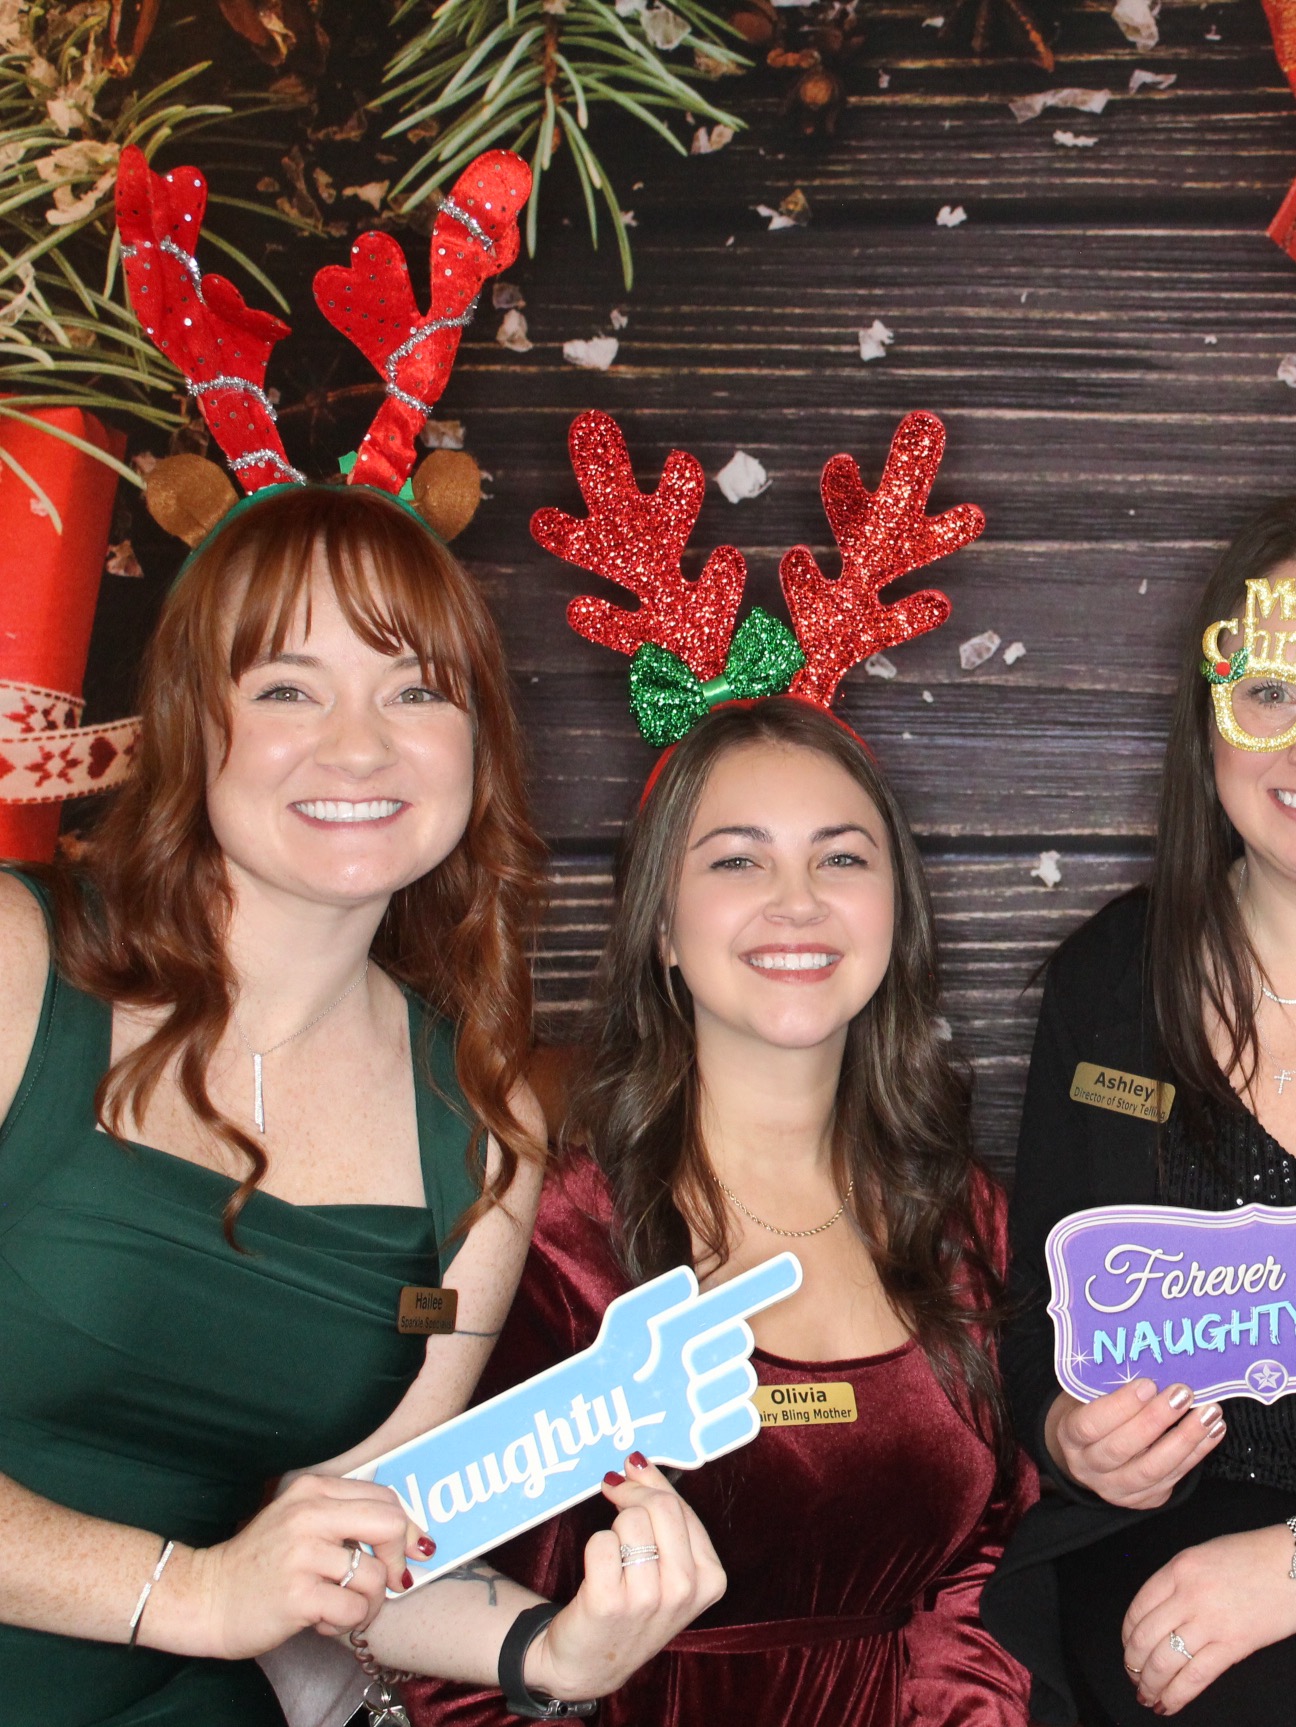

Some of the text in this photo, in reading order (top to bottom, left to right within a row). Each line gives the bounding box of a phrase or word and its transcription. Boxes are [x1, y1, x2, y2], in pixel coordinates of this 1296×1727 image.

[1094, 1071, 1155, 1102] Ashley
[1074, 1087, 1105, 1103] Director
[1106, 1096, 1117, 1106] of
[1116, 1098, 1138, 1113] Story
[1085, 1243, 1286, 1314] Forever
[415, 1291, 443, 1310] Hailee
[770, 1387, 827, 1405] Olivia
[759, 1407, 852, 1424] iry Bling Mother
[388, 1385, 667, 1533] Naughty
